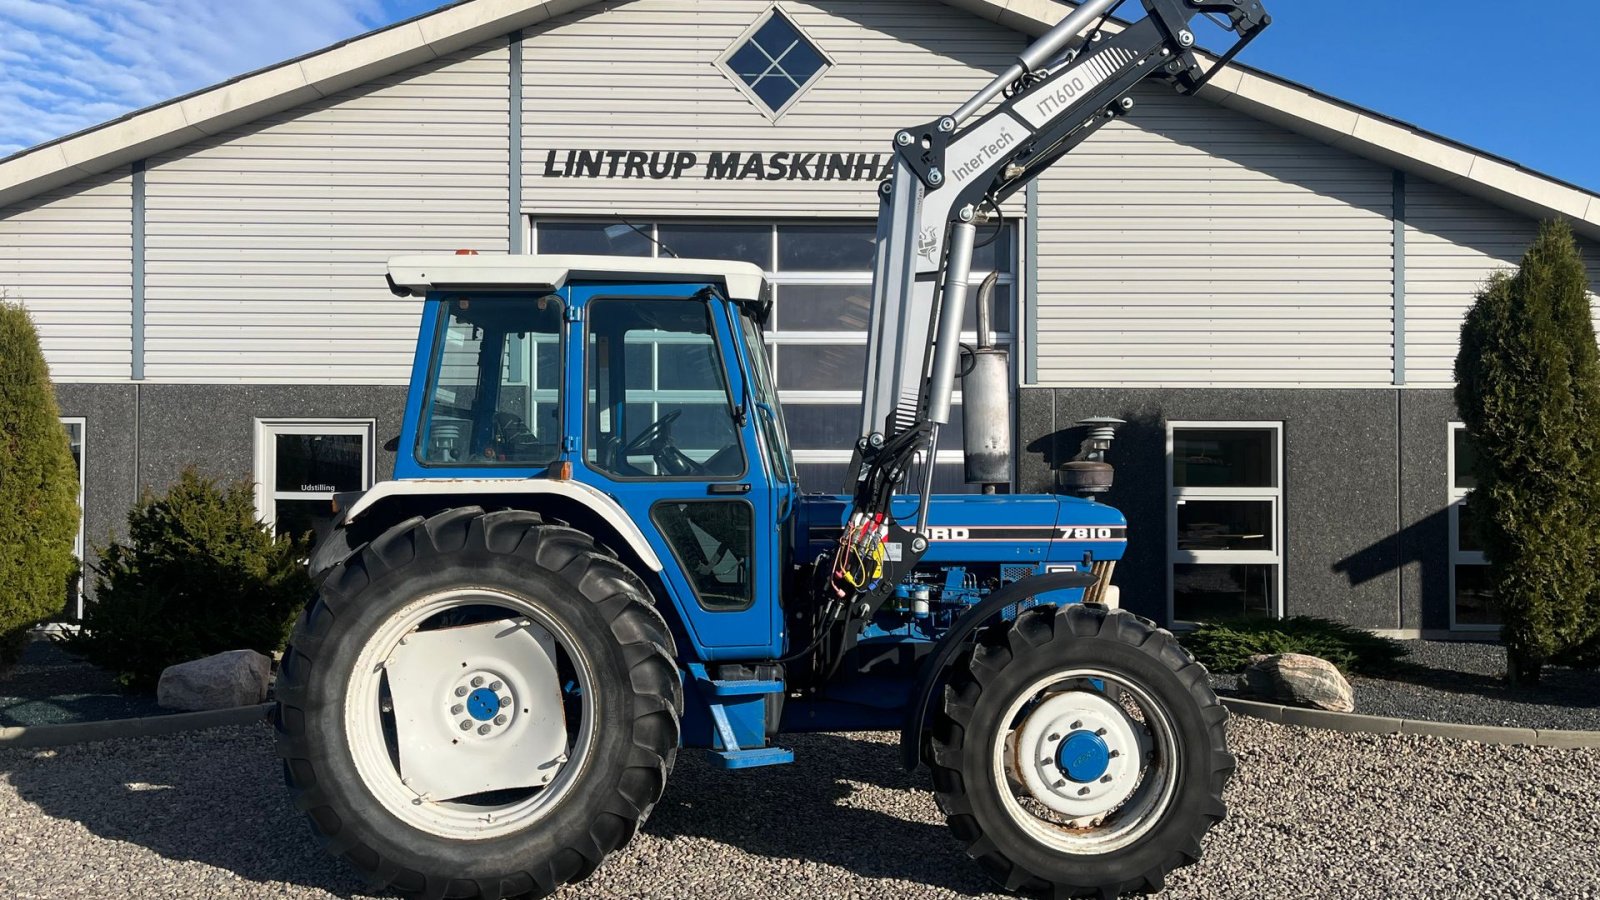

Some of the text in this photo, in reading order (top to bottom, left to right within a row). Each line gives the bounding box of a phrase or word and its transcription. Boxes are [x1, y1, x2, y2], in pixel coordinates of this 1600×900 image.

[1037, 77, 1084, 117] IT1600
[542, 149, 697, 180] LINTRUP
[301, 484, 335, 493] Udstilling
[1060, 528, 1111, 539] 7810
